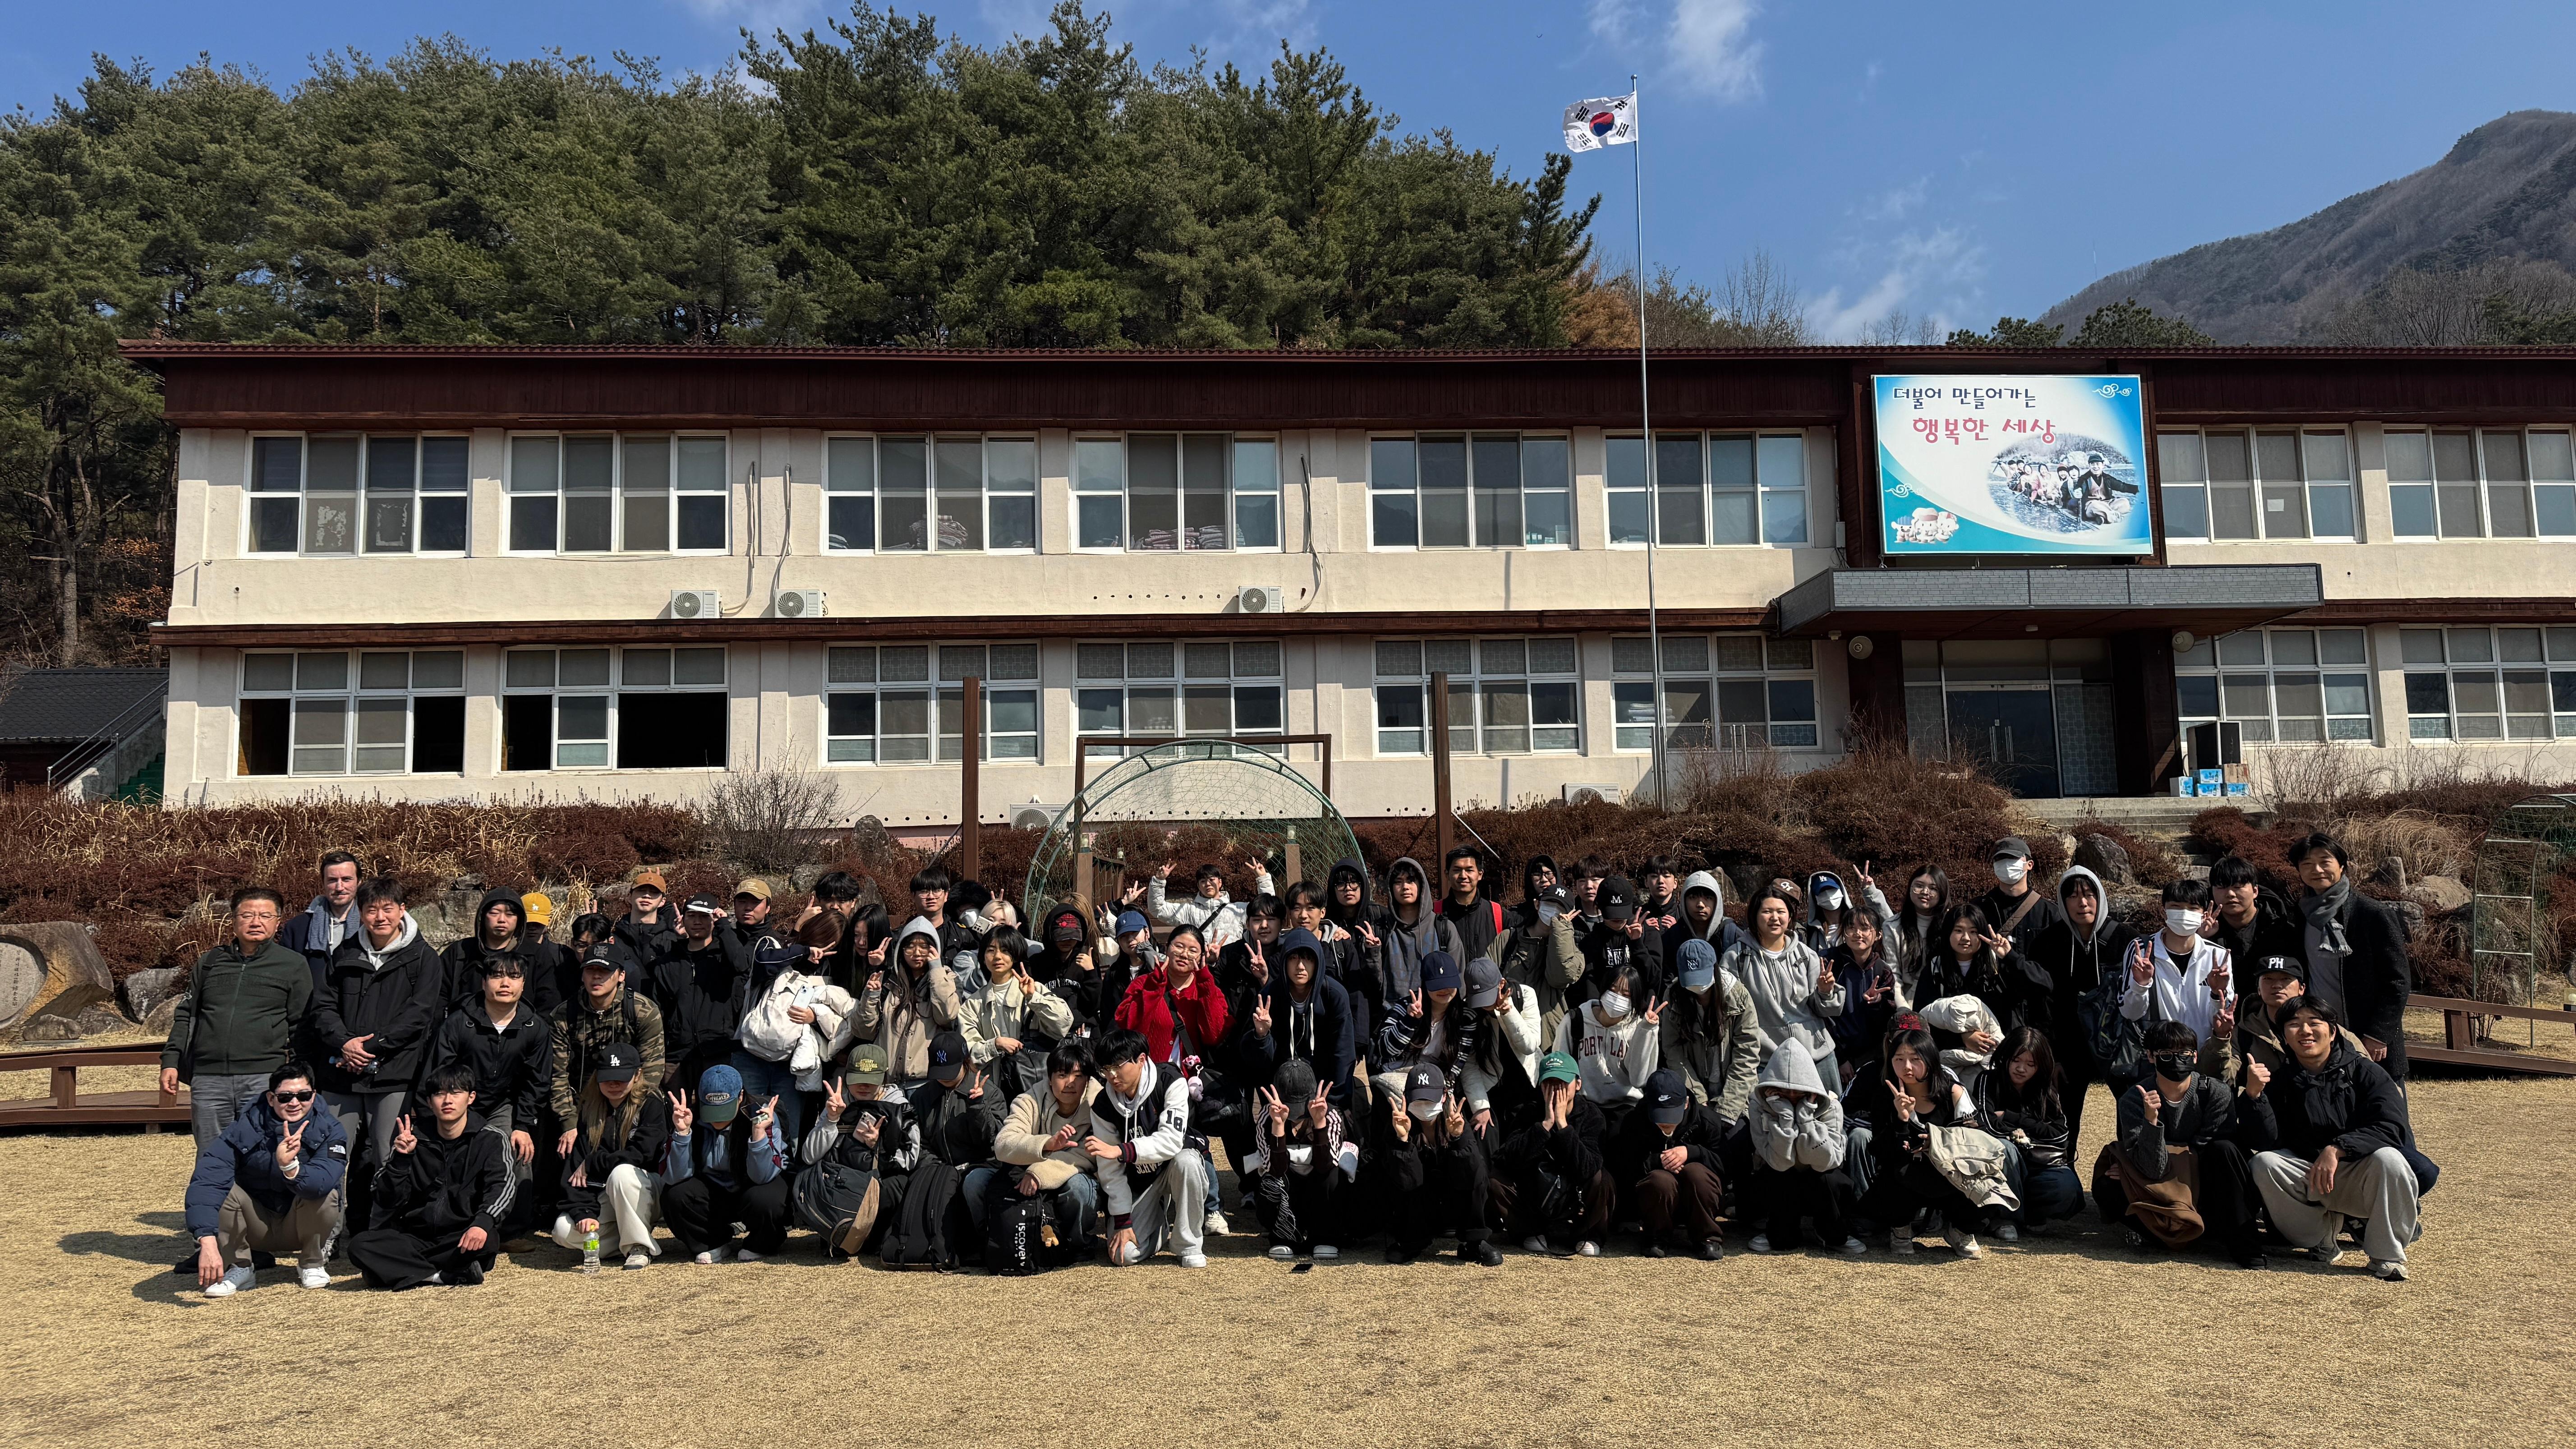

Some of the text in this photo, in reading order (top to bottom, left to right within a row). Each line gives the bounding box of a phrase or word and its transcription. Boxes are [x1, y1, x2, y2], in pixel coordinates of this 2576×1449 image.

[1893, 387, 2036, 409] 더불어 만들어가는
[1913, 417, 2056, 445] 행복한 세상
[2268, 957, 2284, 969] PH
[610, 1054, 620, 1066] LA
[937, 1050, 947, 1063] NY
[1418, 1073, 1429, 1085] NY
